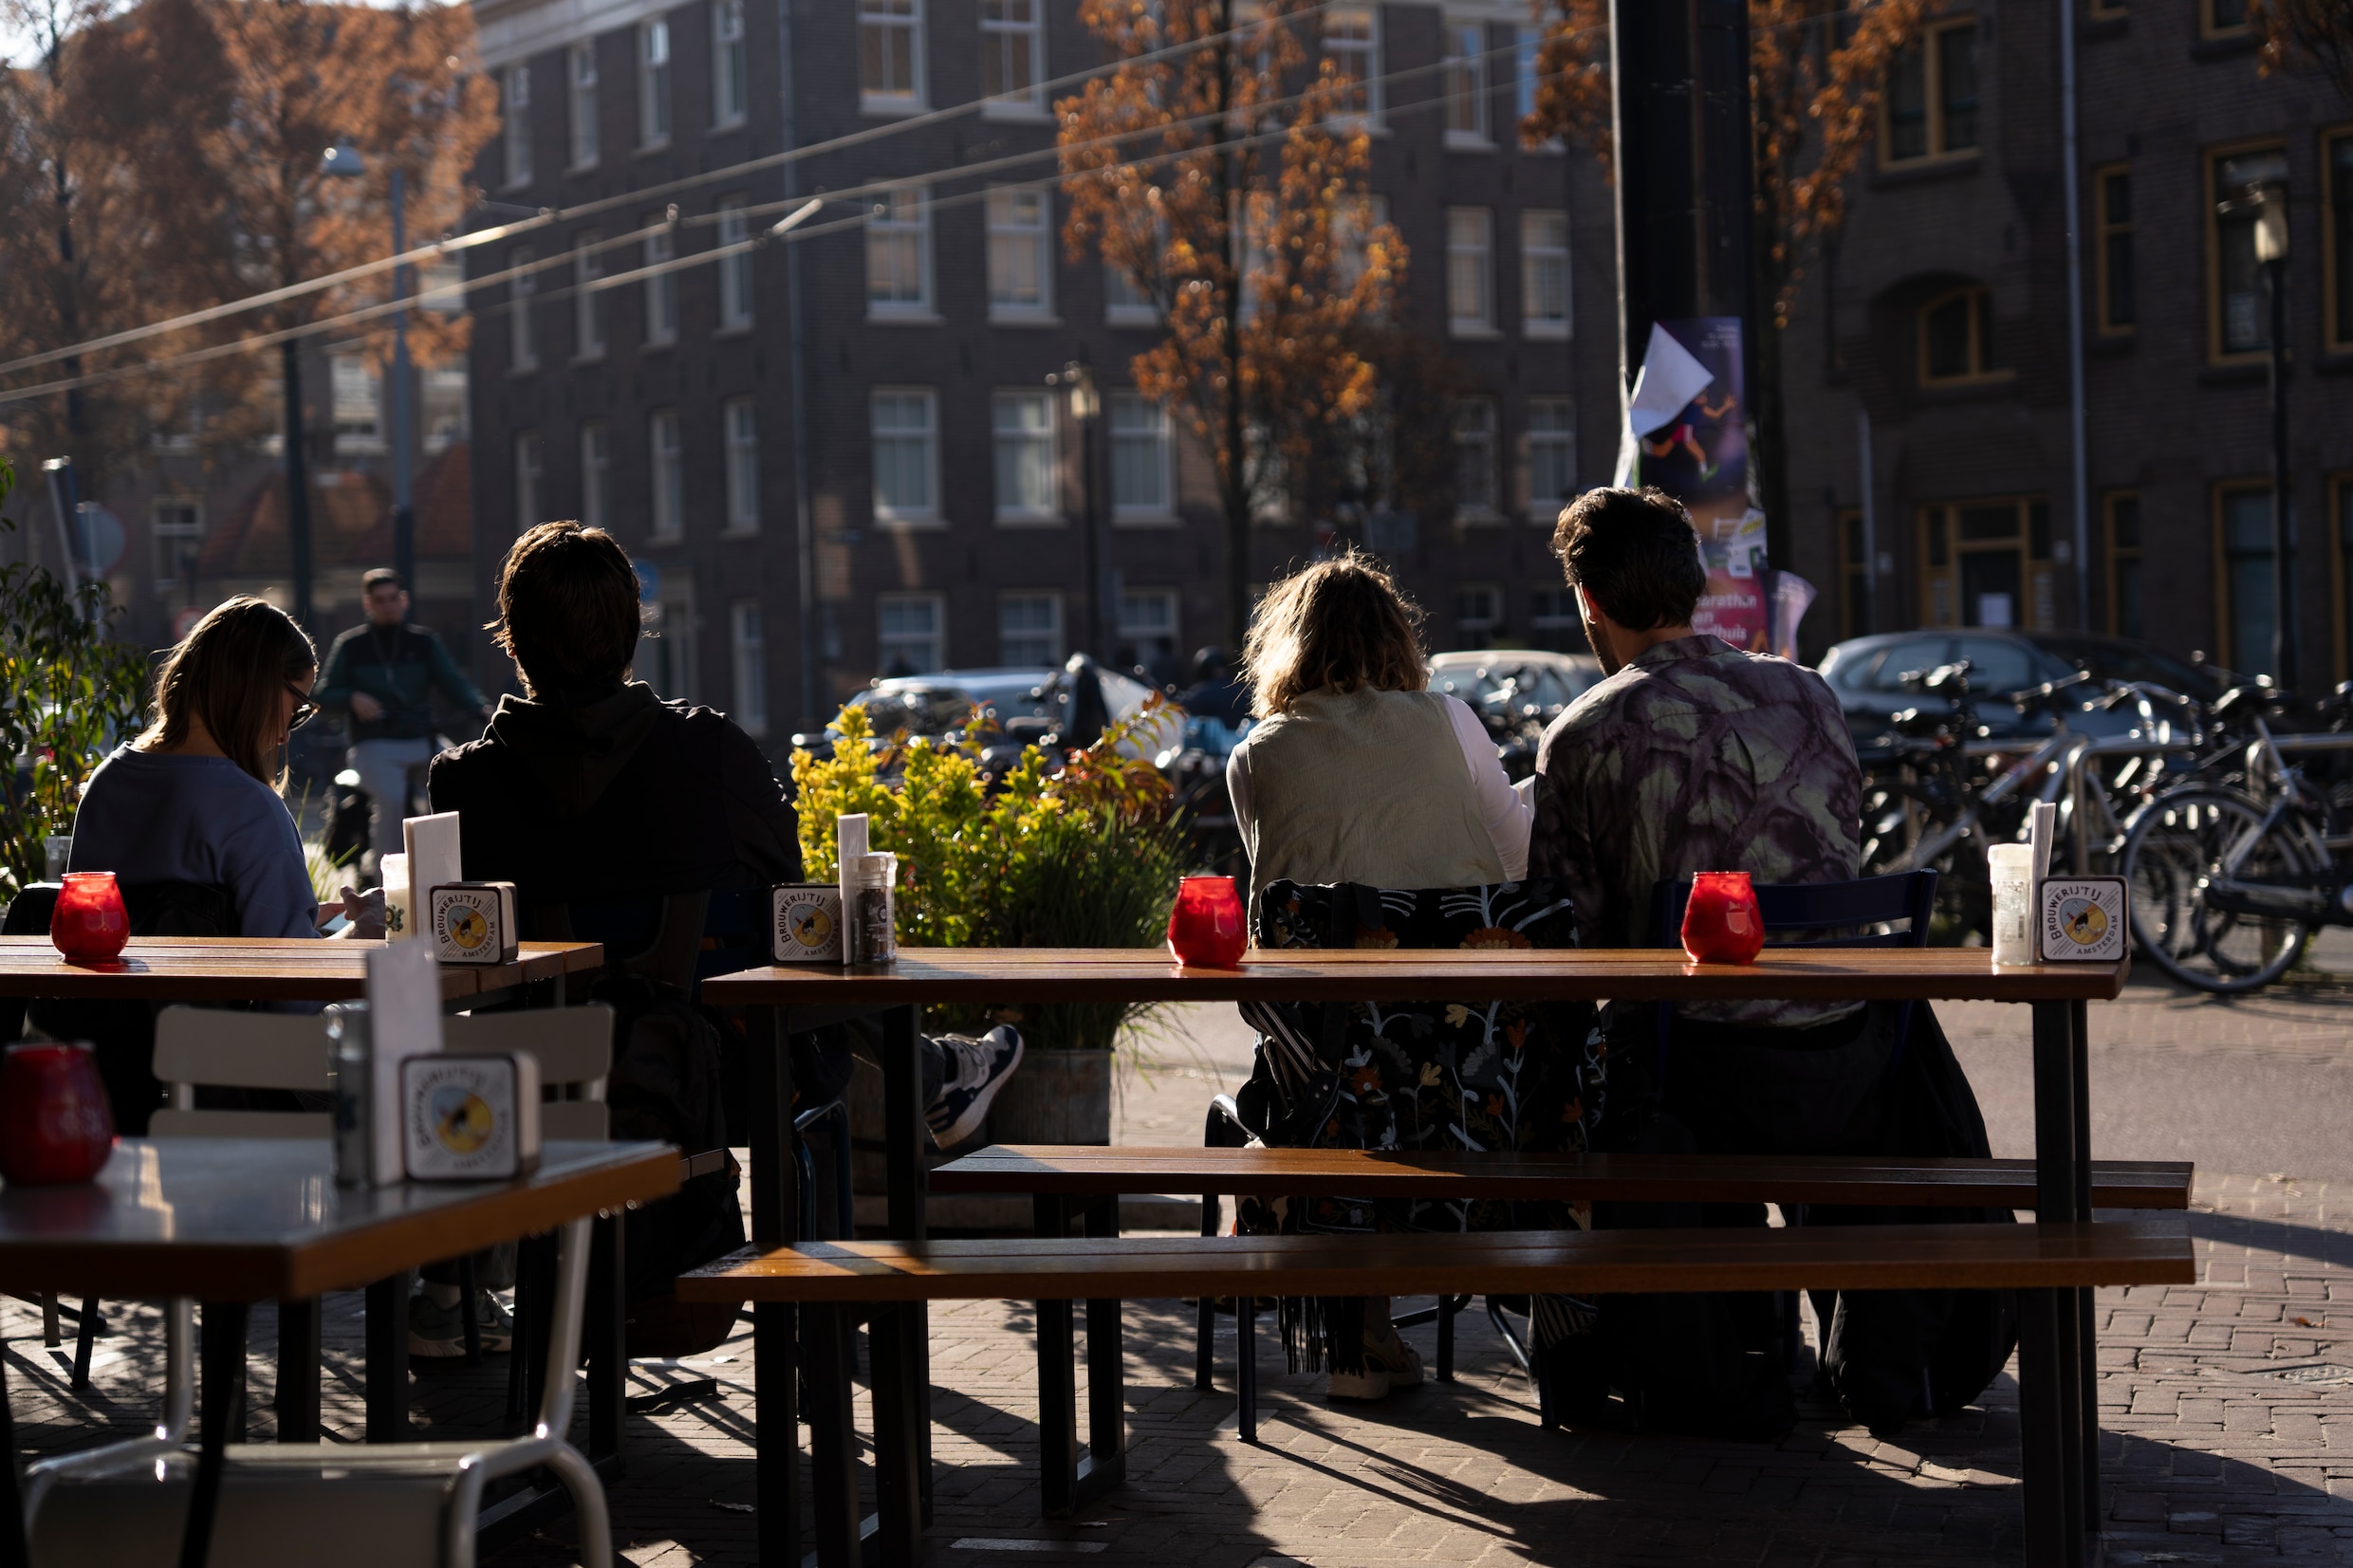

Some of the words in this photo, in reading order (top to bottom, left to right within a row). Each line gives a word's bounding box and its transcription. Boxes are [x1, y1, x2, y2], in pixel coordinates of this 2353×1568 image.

[1692, 611, 1714, 624] an
[461, 921, 495, 958] AMSTERDAM
[804, 918, 840, 956] AMSTERDAM
[2076, 914, 2119, 955] AMSTERDAM
